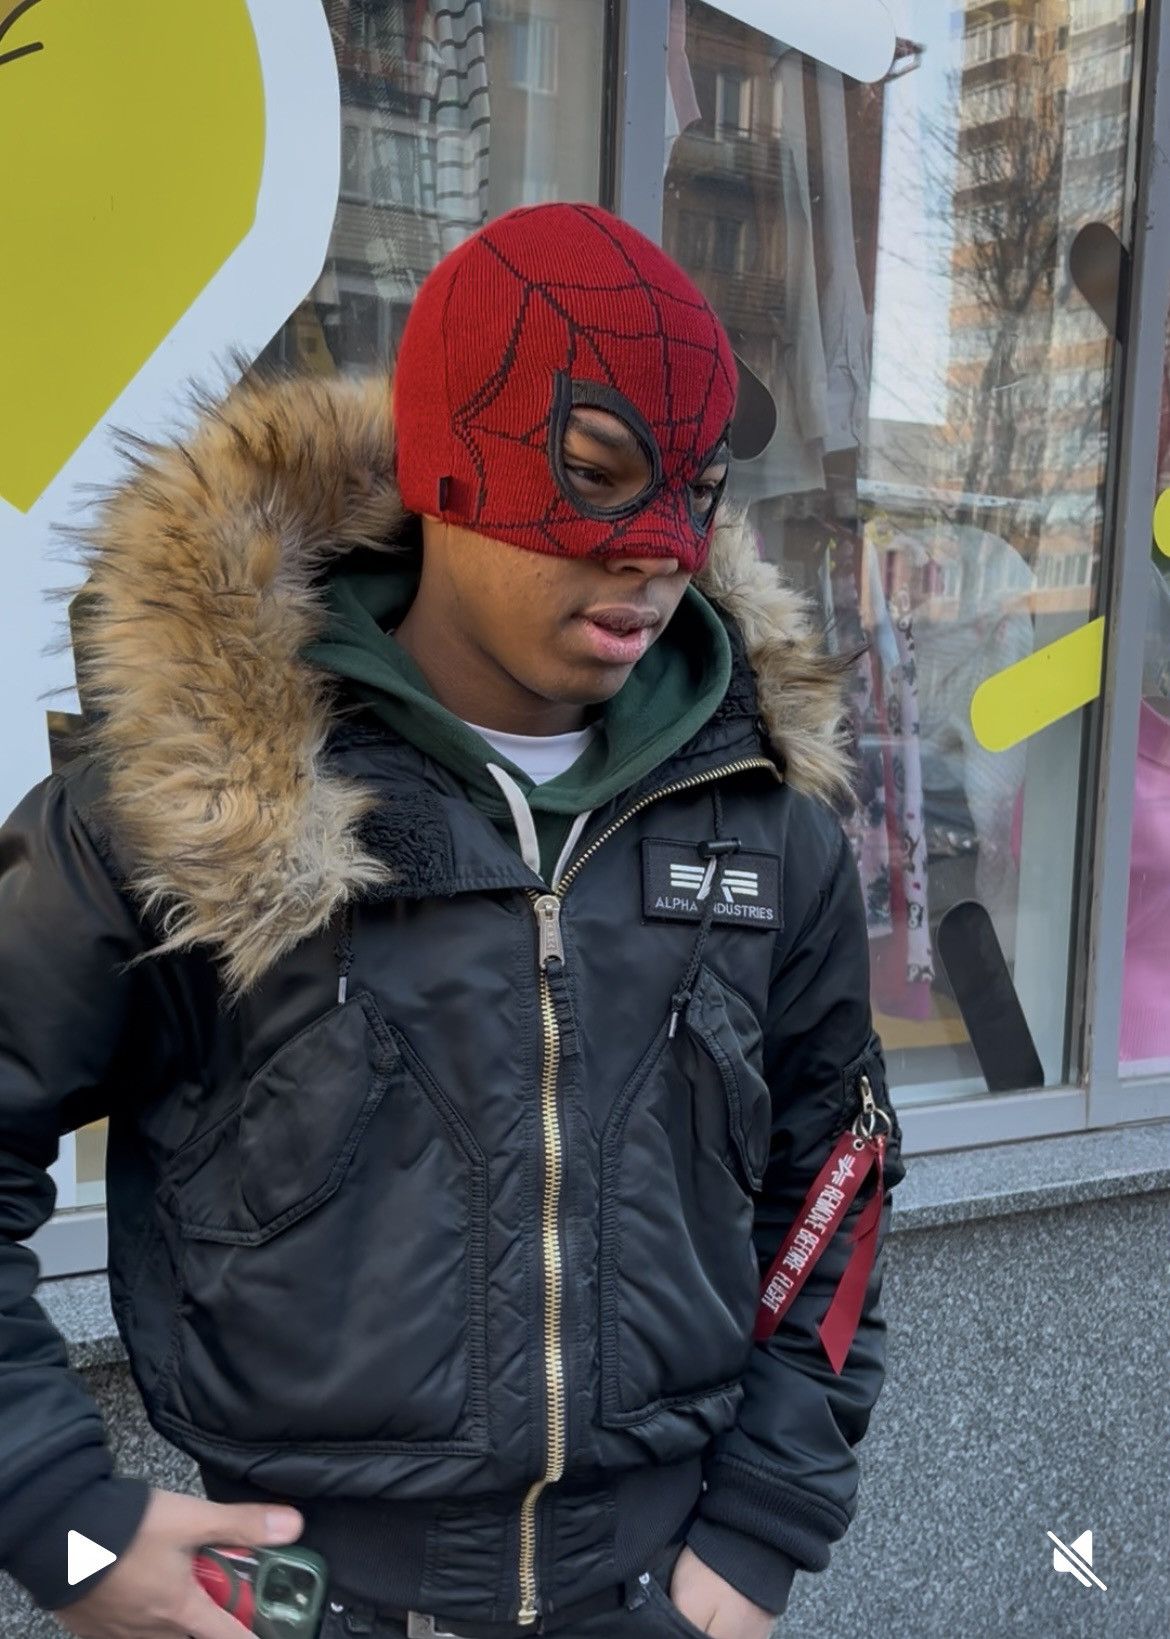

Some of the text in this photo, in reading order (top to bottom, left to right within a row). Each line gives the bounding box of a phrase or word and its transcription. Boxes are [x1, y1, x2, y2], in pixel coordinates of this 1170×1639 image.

[655, 896, 698, 912] ALPHA
[761, 1184, 846, 1314] REMOVE BEFORE FLIGHT
